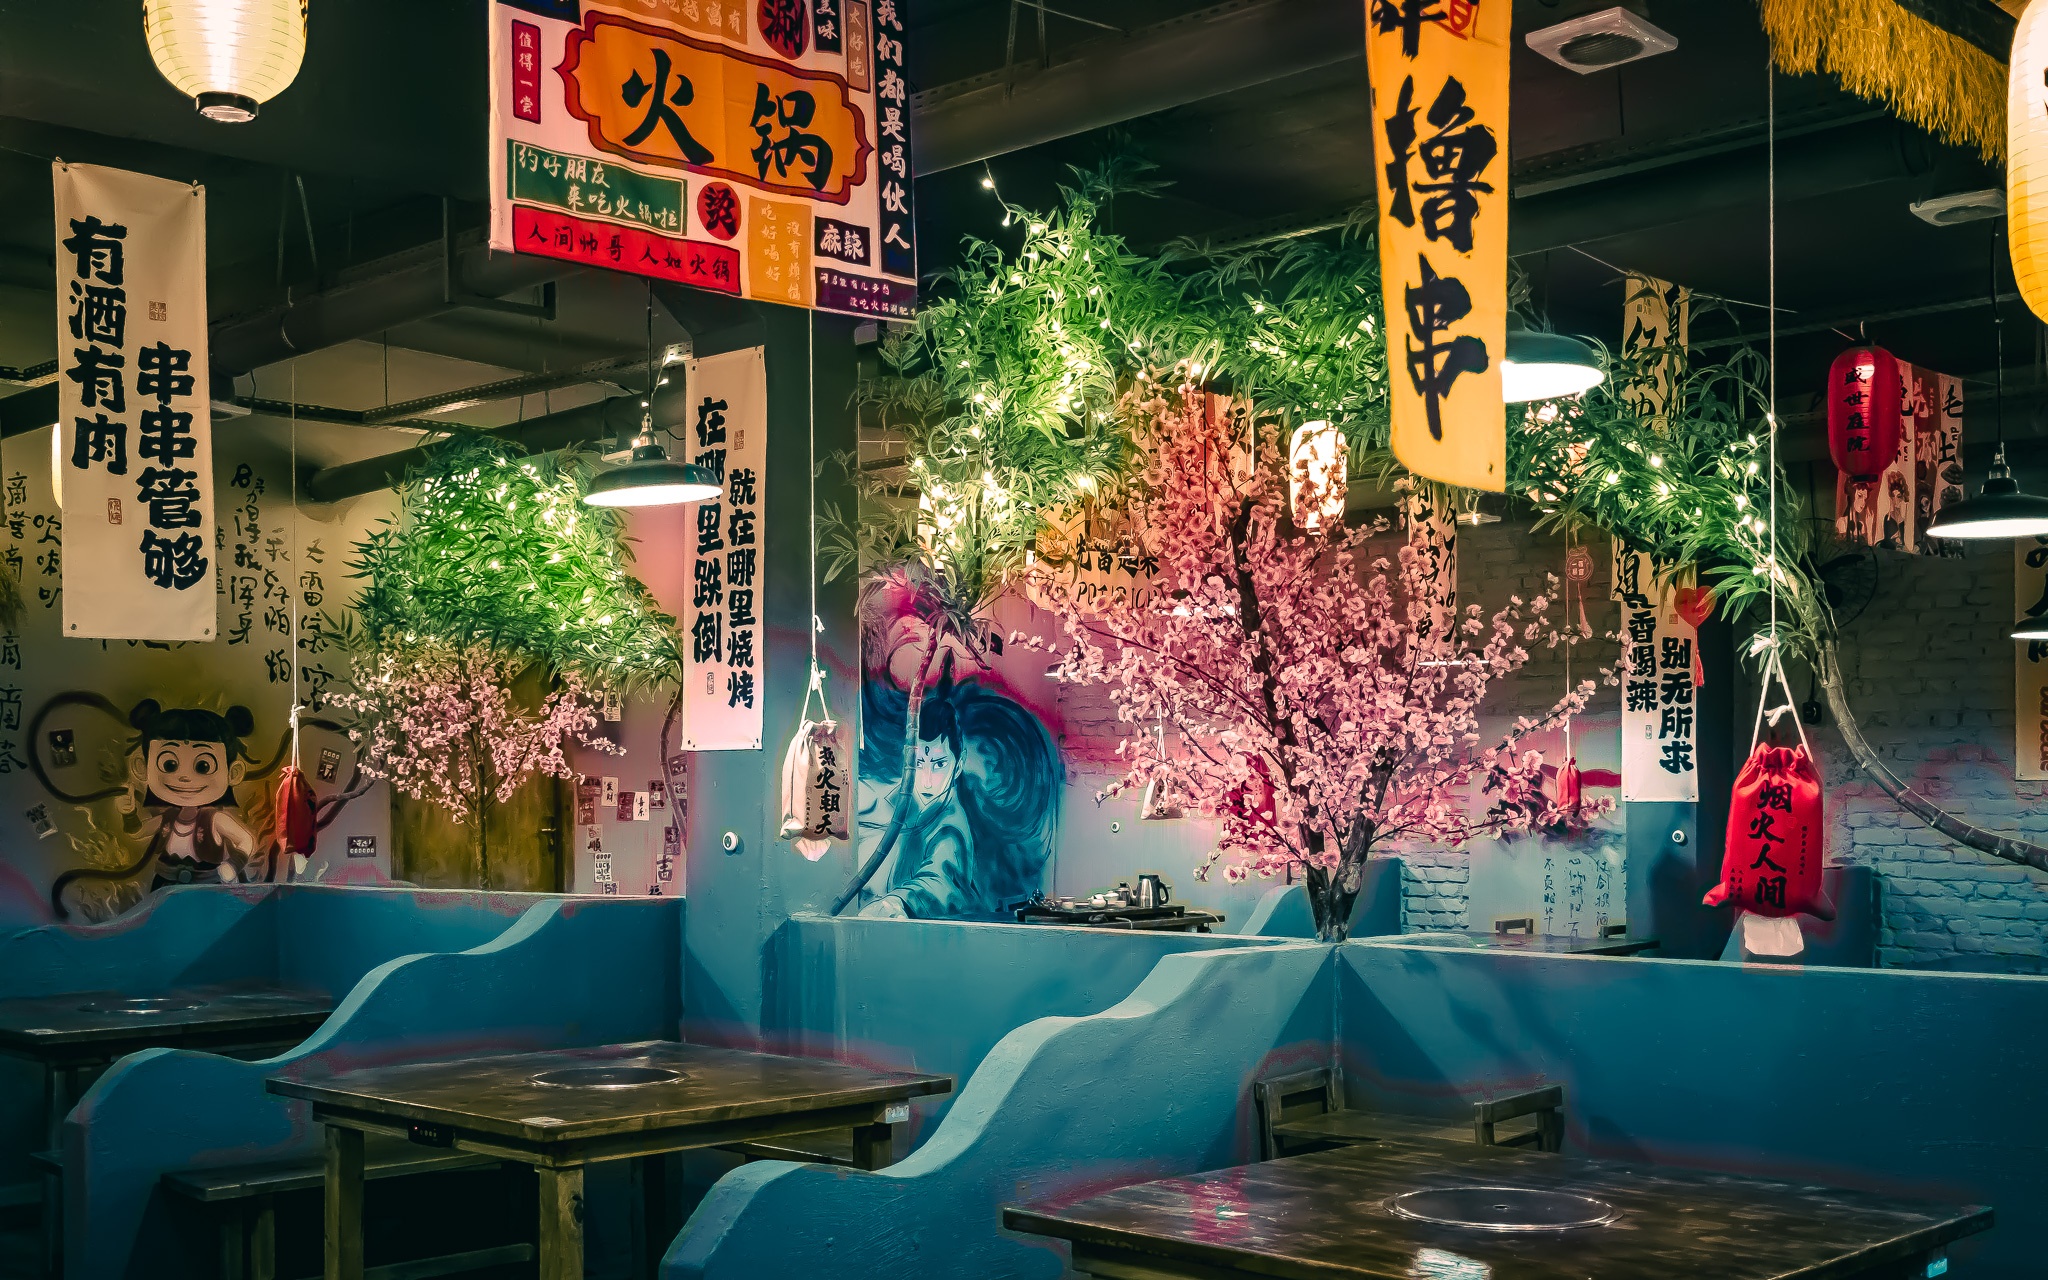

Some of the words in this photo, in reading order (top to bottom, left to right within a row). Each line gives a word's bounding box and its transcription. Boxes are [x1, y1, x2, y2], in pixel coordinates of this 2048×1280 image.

[518, 31, 534, 115] 值得一尝
[622, 48, 833, 191] 火锅
[518, 145, 611, 188] 约好朋友
[761, 203, 781, 282] 吃好喝好
[819, 223, 865, 260] 麻辣
[62, 214, 129, 476] 有酒有肉
[136, 341, 208, 591] 串串管够
[726, 468, 756, 710] 就在哪里烧烤
[1626, 598, 1659, 713] 香喝辣
[1659, 637, 1695, 774] 别无所求
[1748, 780, 1793, 909] 烟火人间
